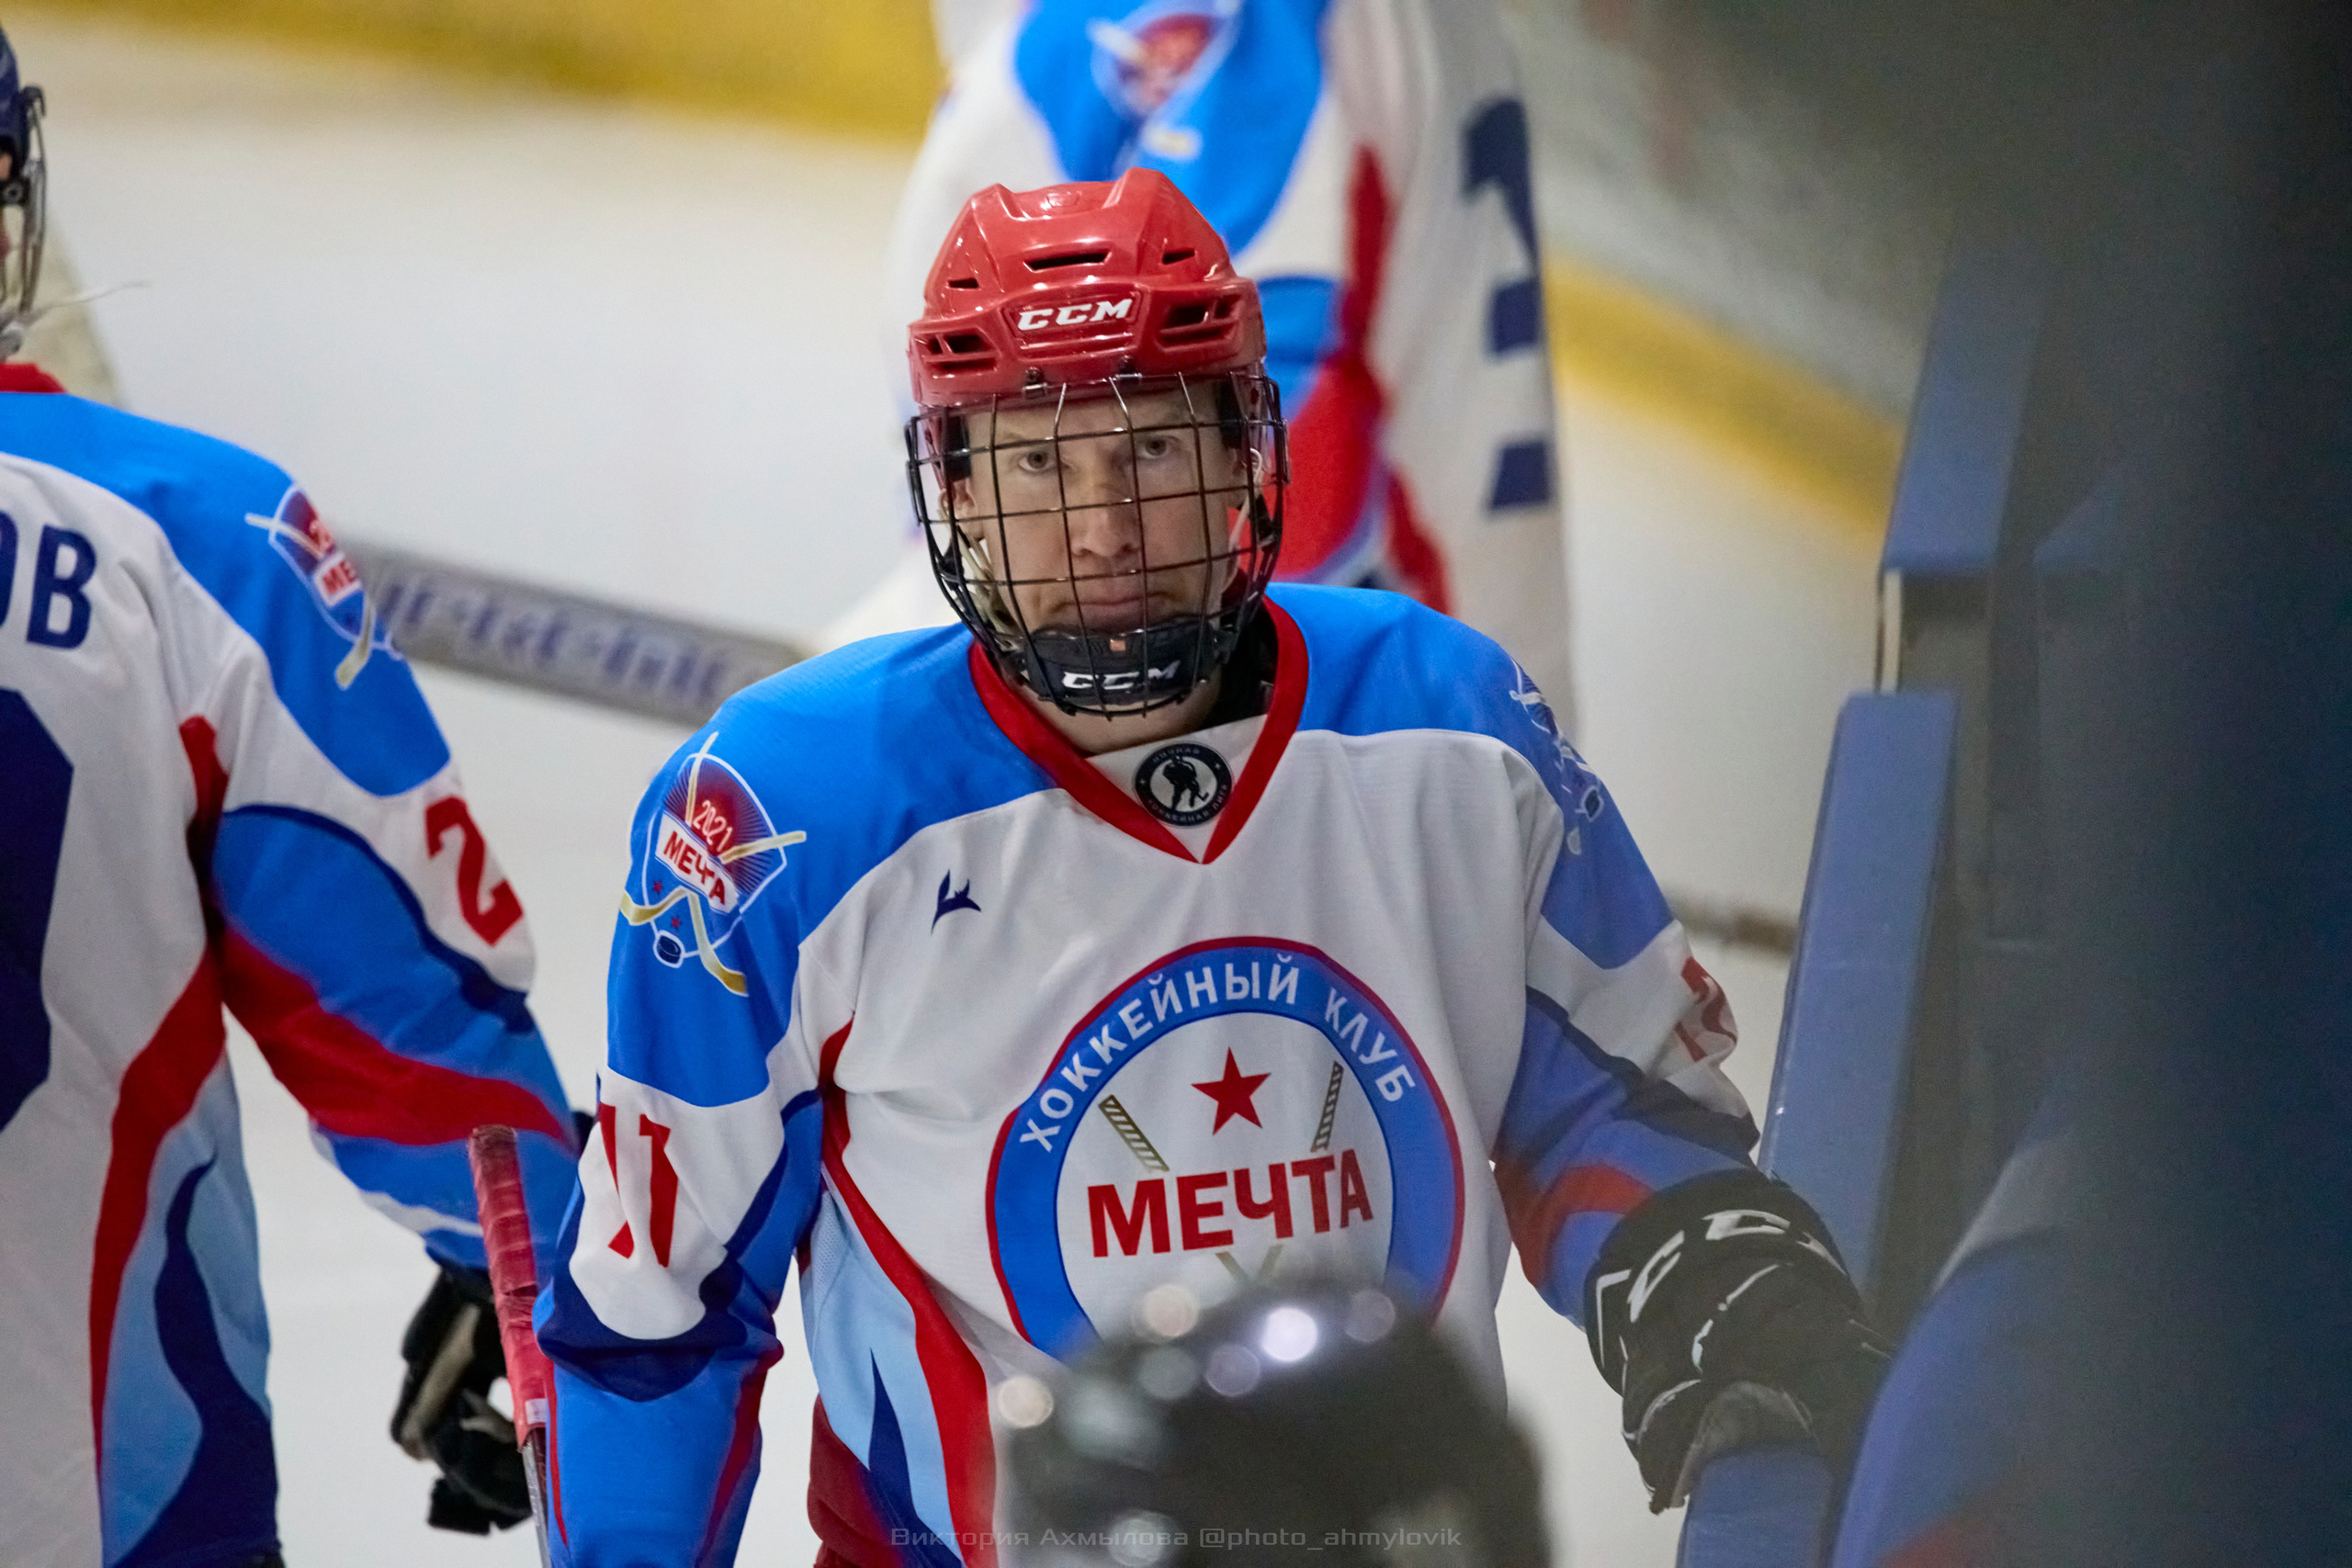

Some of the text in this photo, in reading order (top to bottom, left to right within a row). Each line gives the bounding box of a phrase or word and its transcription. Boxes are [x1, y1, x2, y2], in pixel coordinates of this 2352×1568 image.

[1017, 299, 1133, 331] CCM
[1062, 660, 1181, 690] CCM
[693, 800, 733, 853] 2021
[1020, 953, 1417, 1153] ХОККЕЙНЫЙ КЛУБ
[1088, 1149, 1374, 1258] МЕЧТА
